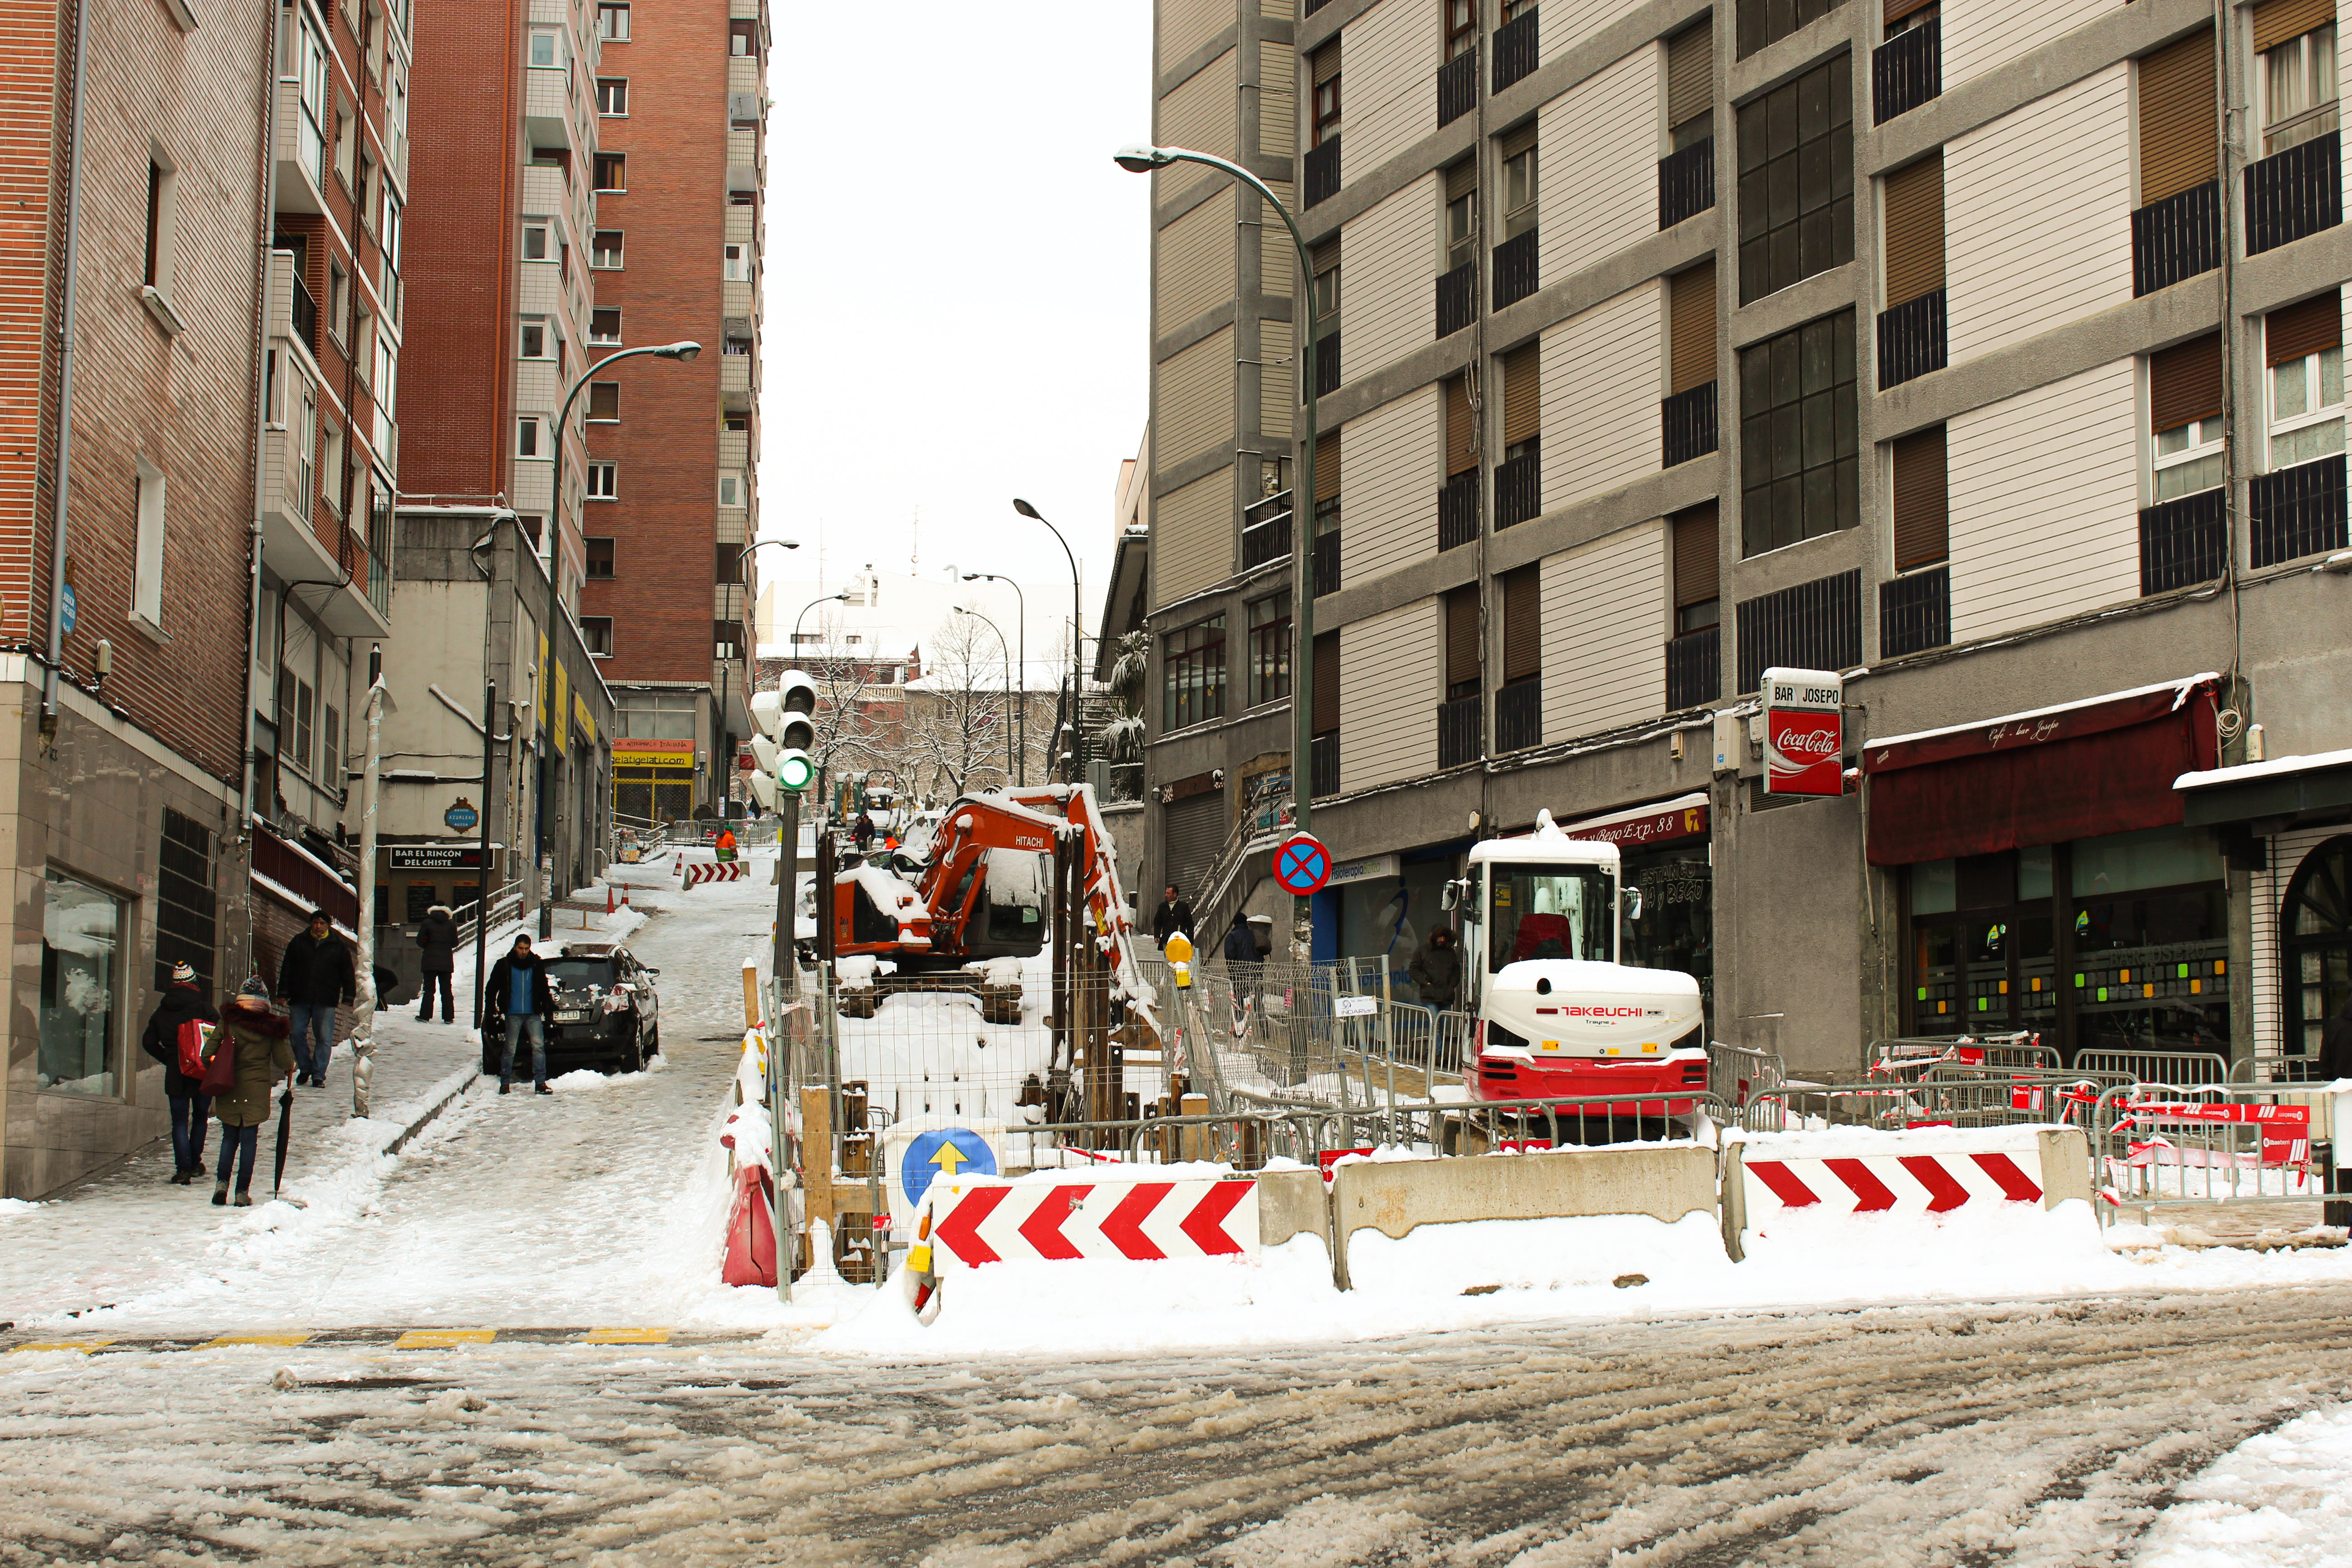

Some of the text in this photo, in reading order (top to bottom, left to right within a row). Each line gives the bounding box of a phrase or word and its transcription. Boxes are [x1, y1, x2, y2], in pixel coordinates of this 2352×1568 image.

[1775, 686, 1838, 704] BAR JOSEPO
[1777, 728, 1838, 753] Coca-Cola
[1989, 724, 2007, 748] Café
[2015, 723, 2030, 735] bar
[2030, 720, 2059, 741] Josepo
[1623, 823, 1654, 840] Exp.
[1657, 816, 1673, 833] 88
[1016, 835, 1044, 848] HITACHI
[1640, 863, 1695, 885] ESTANCO
[1640, 880, 1703, 910] NA y BEGO
[1561, 1007, 1642, 1017] TAKEUCHI
